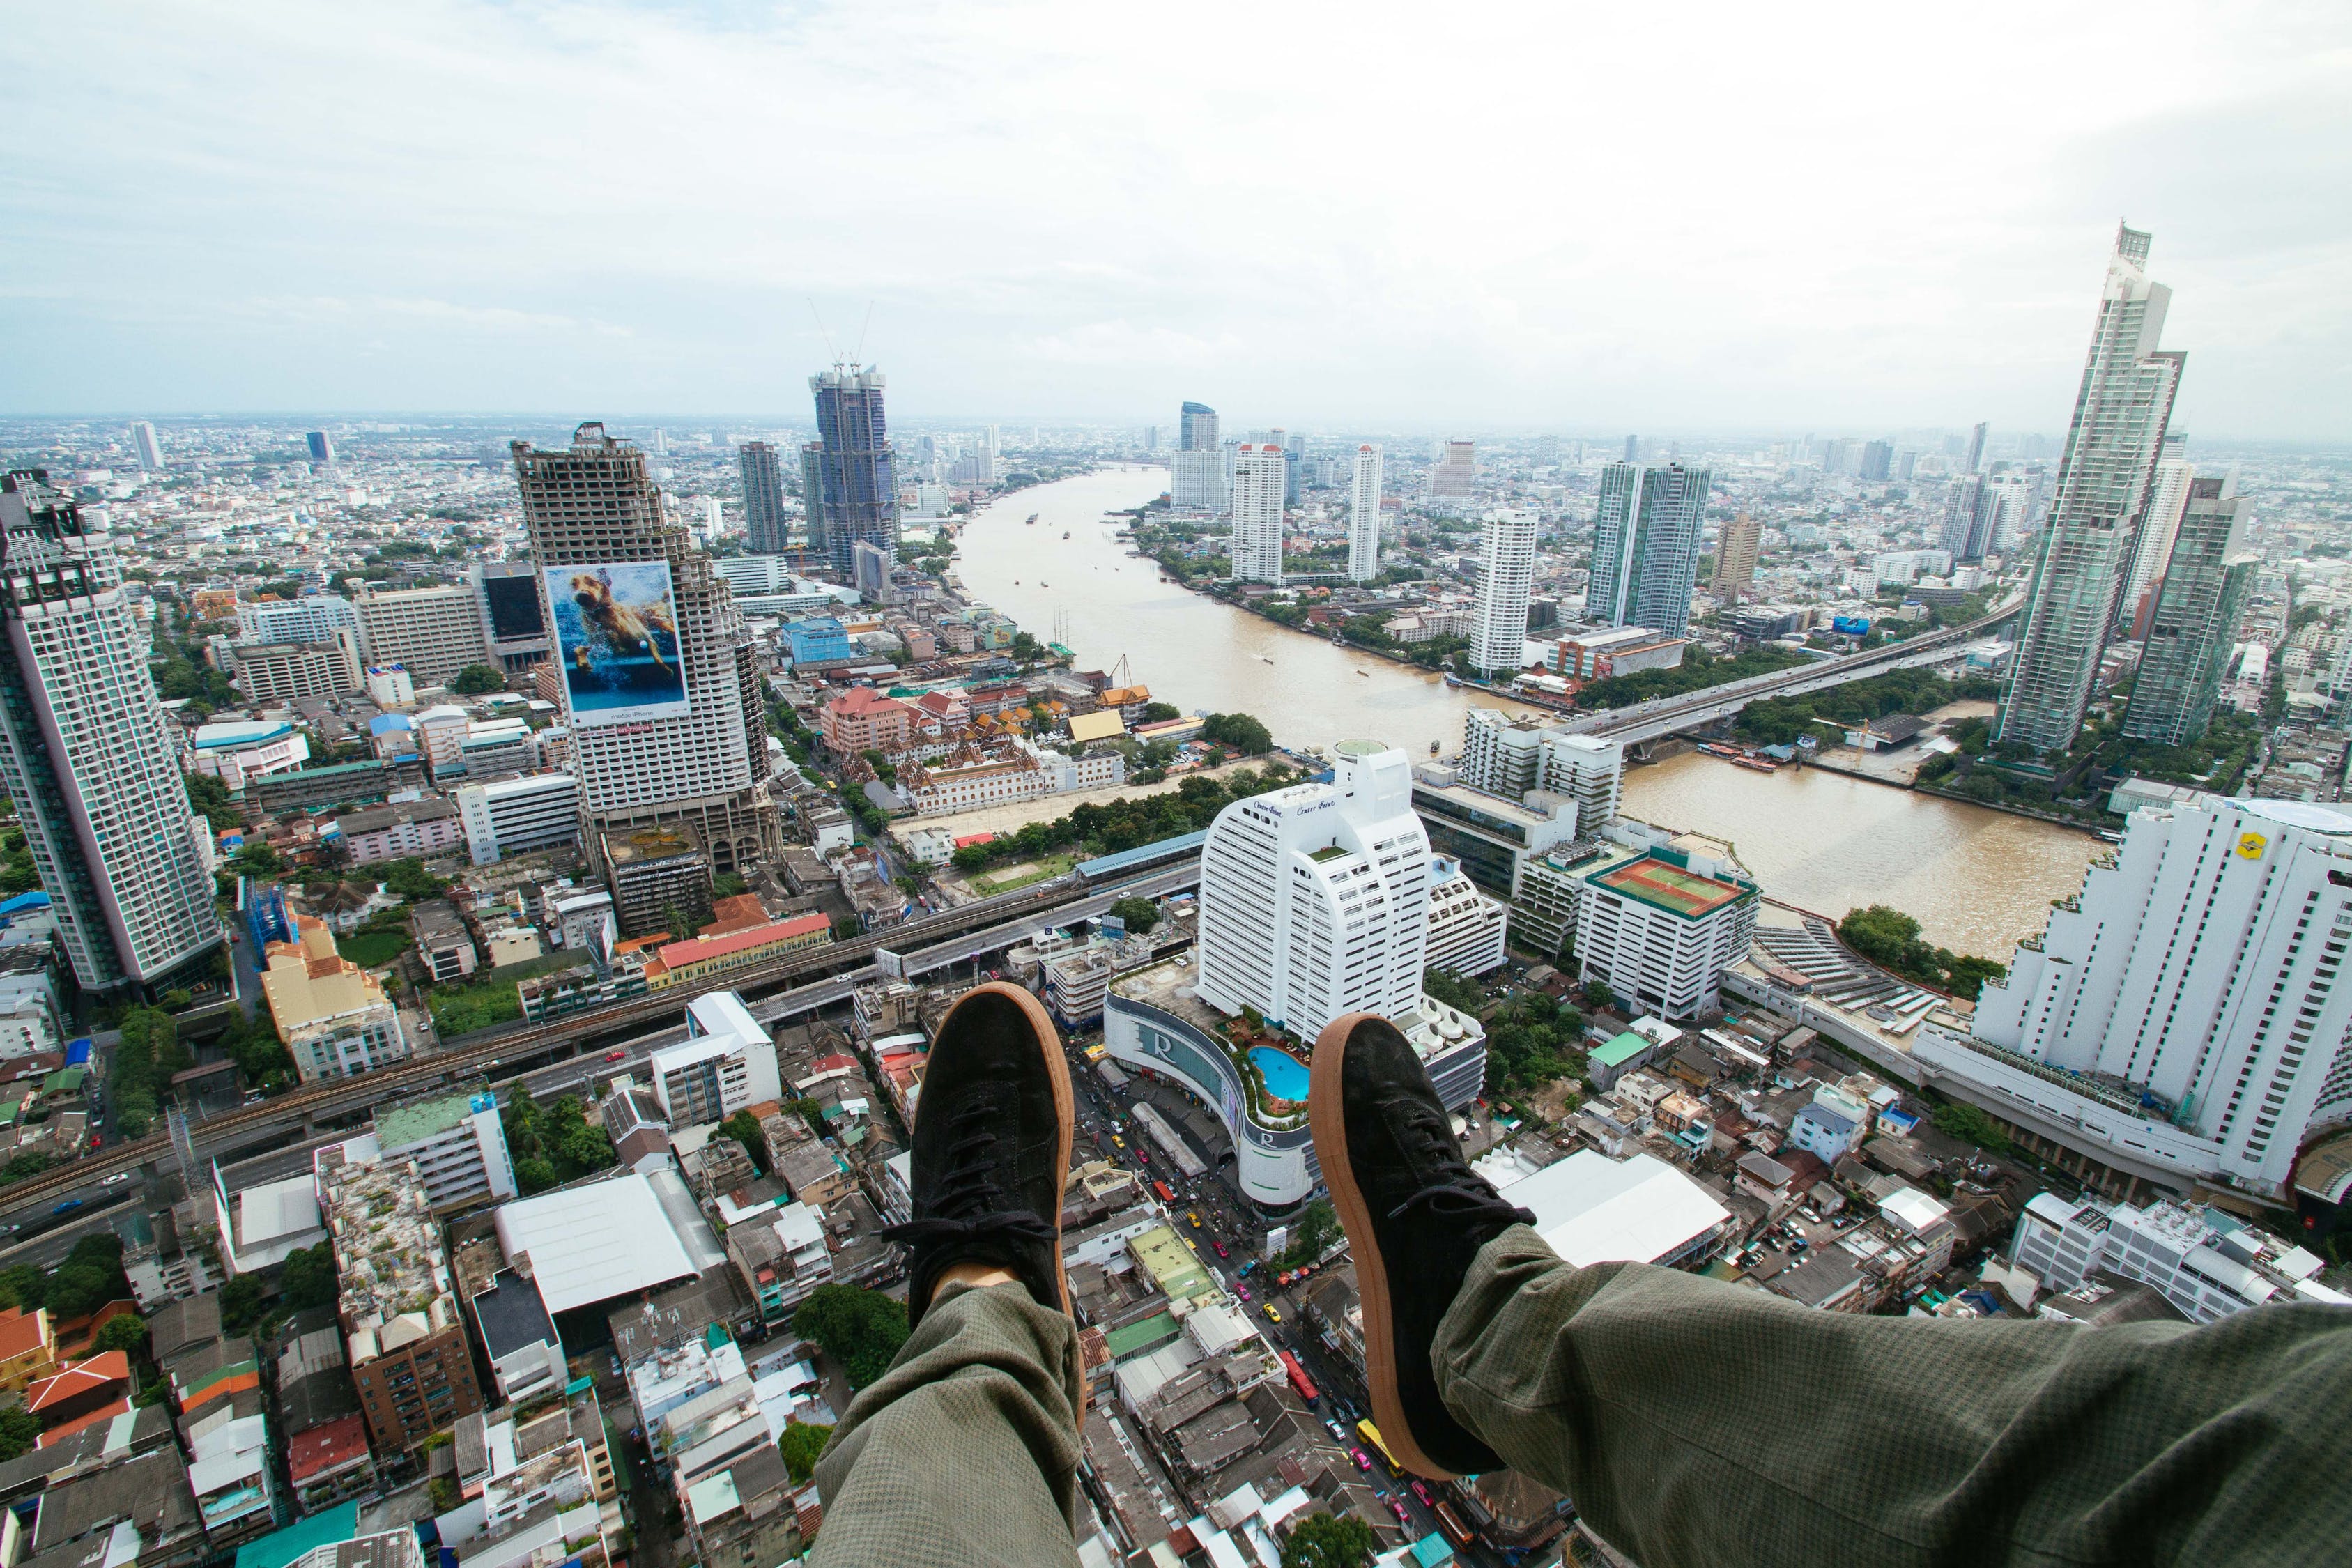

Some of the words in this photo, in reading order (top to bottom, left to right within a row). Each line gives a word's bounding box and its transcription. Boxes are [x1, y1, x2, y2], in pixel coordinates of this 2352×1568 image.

[1254, 801, 1269, 813] Centre
[1268, 806, 1283, 817] Point
[1297, 807, 1316, 816] Centre
[1318, 800, 1335, 809] Point
[1154, 1033, 1176, 1063] R
[1261, 1132, 1277, 1148] R
